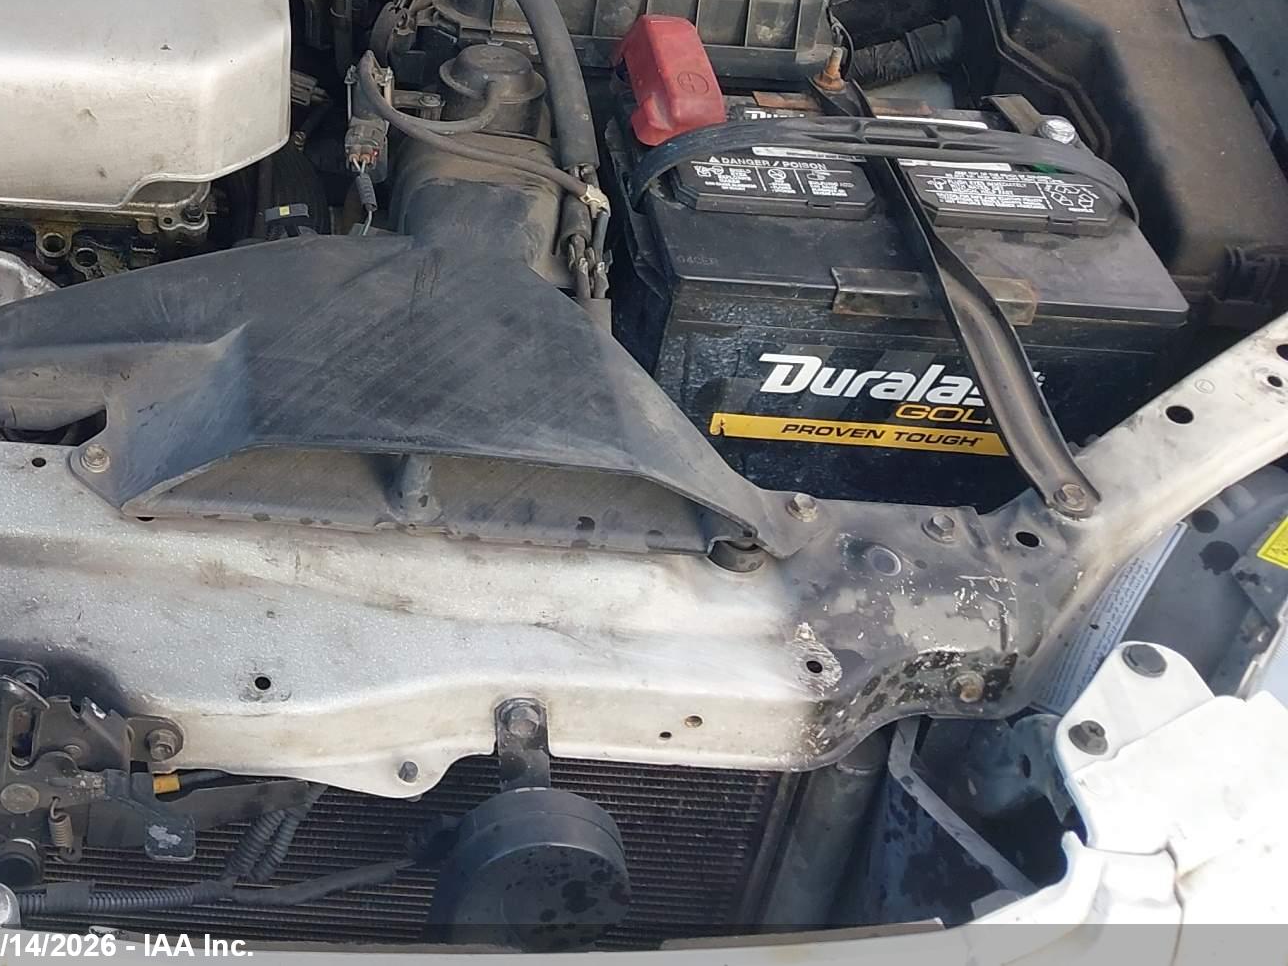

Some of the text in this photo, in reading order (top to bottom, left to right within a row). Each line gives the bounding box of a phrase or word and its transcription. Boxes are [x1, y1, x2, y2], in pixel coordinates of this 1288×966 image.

[721, 156, 770, 167] DANGER
[782, 161, 828, 171] POISON
[894, 403, 994, 425] GOL
[781, 423, 978, 447] PROVEN TOUGH
